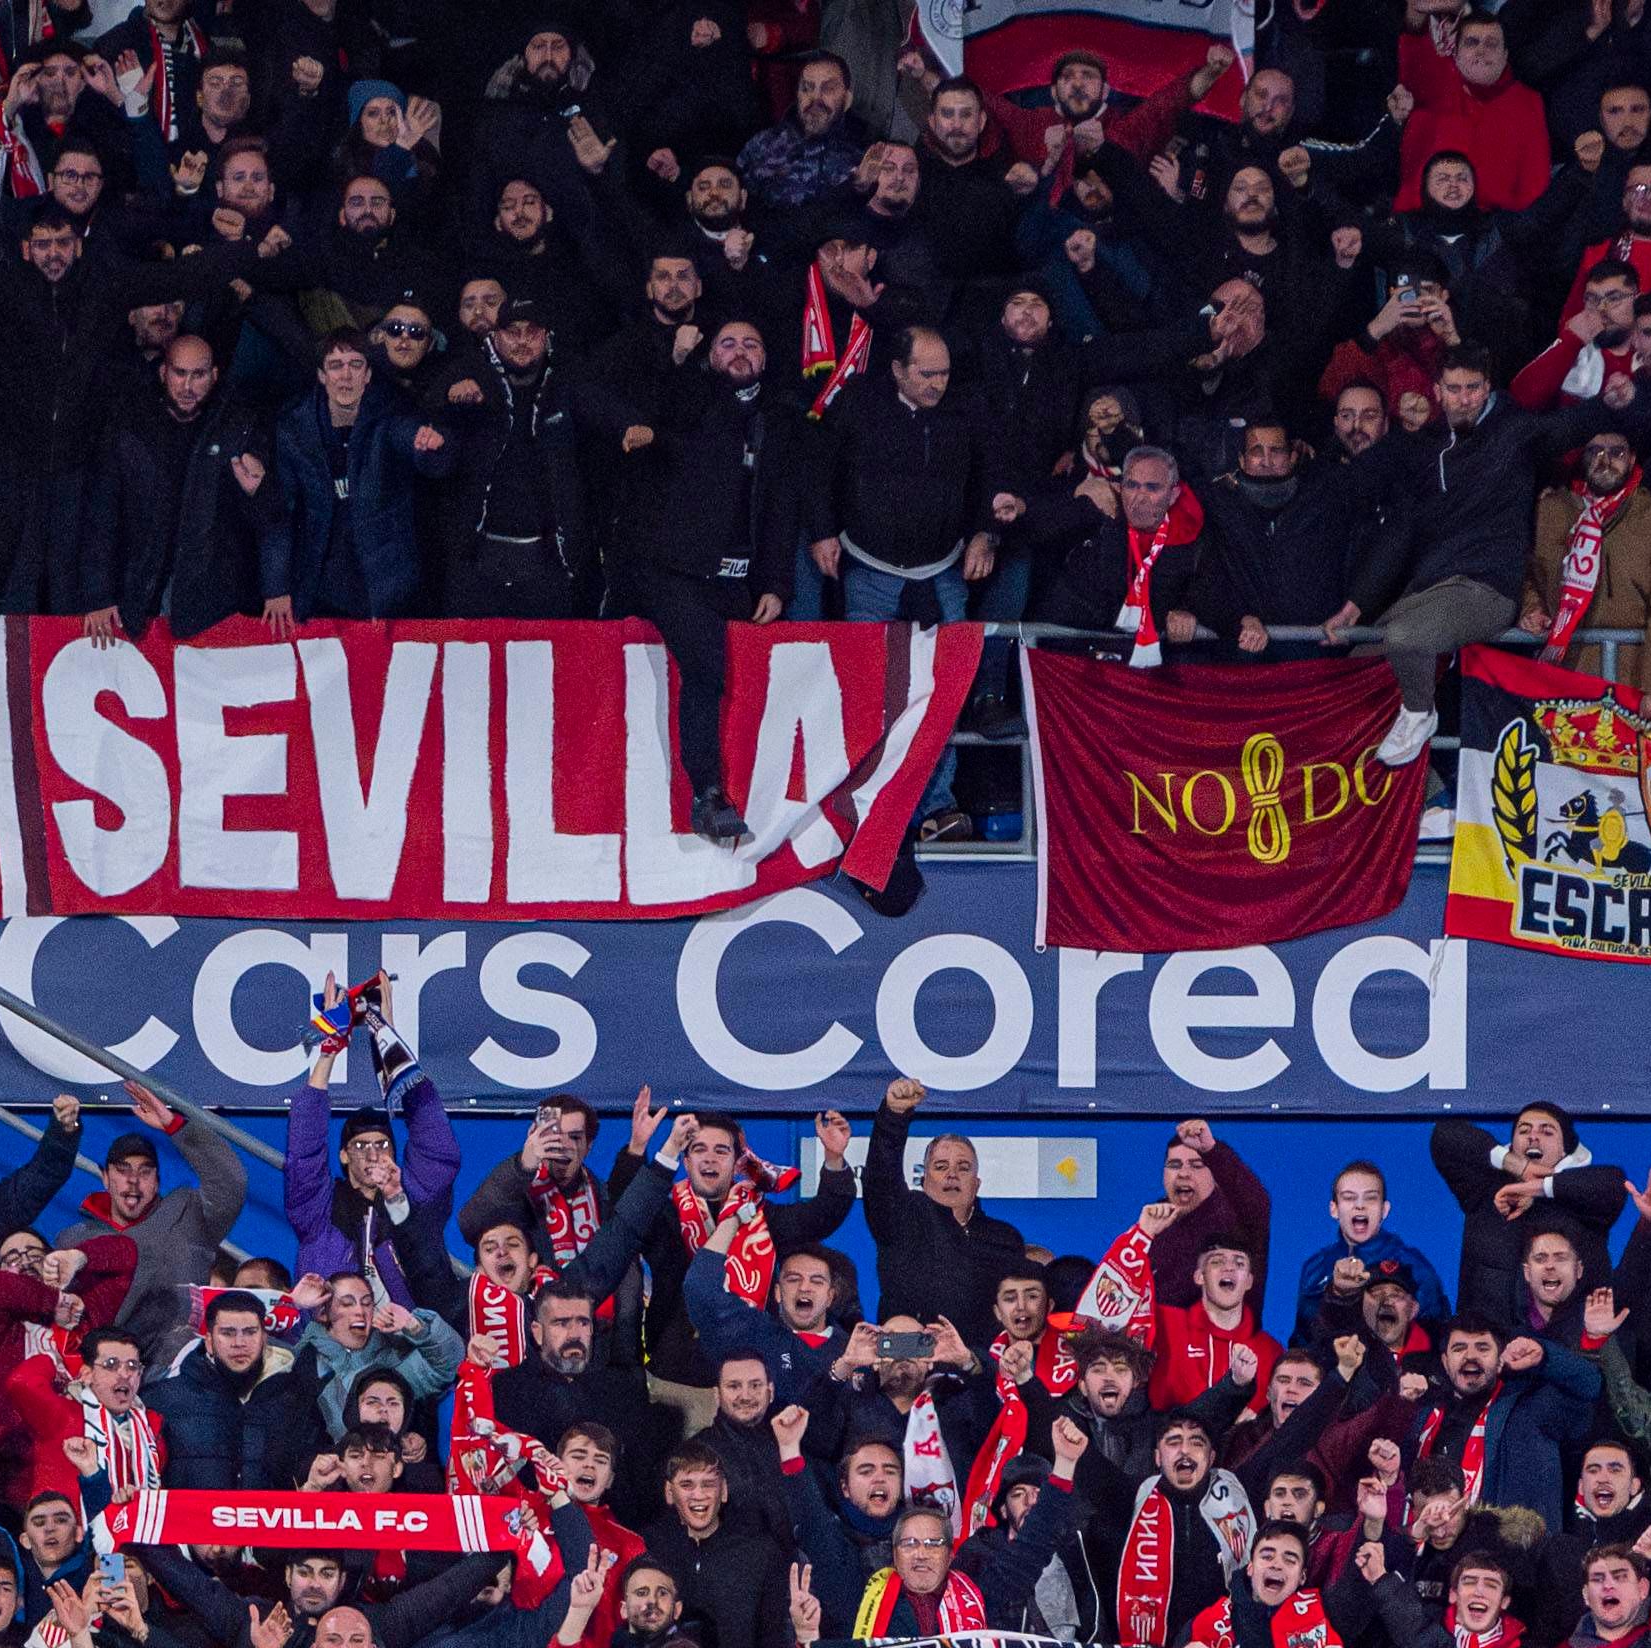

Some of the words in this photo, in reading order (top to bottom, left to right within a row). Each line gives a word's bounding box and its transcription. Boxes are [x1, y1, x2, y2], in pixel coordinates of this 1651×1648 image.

[43, 638, 850, 906] SEVILLA
[676, 888, 1468, 1092] Corea
[212, 1506, 363, 1531] SEVILLA
[376, 1509, 428, 1533] F.C
